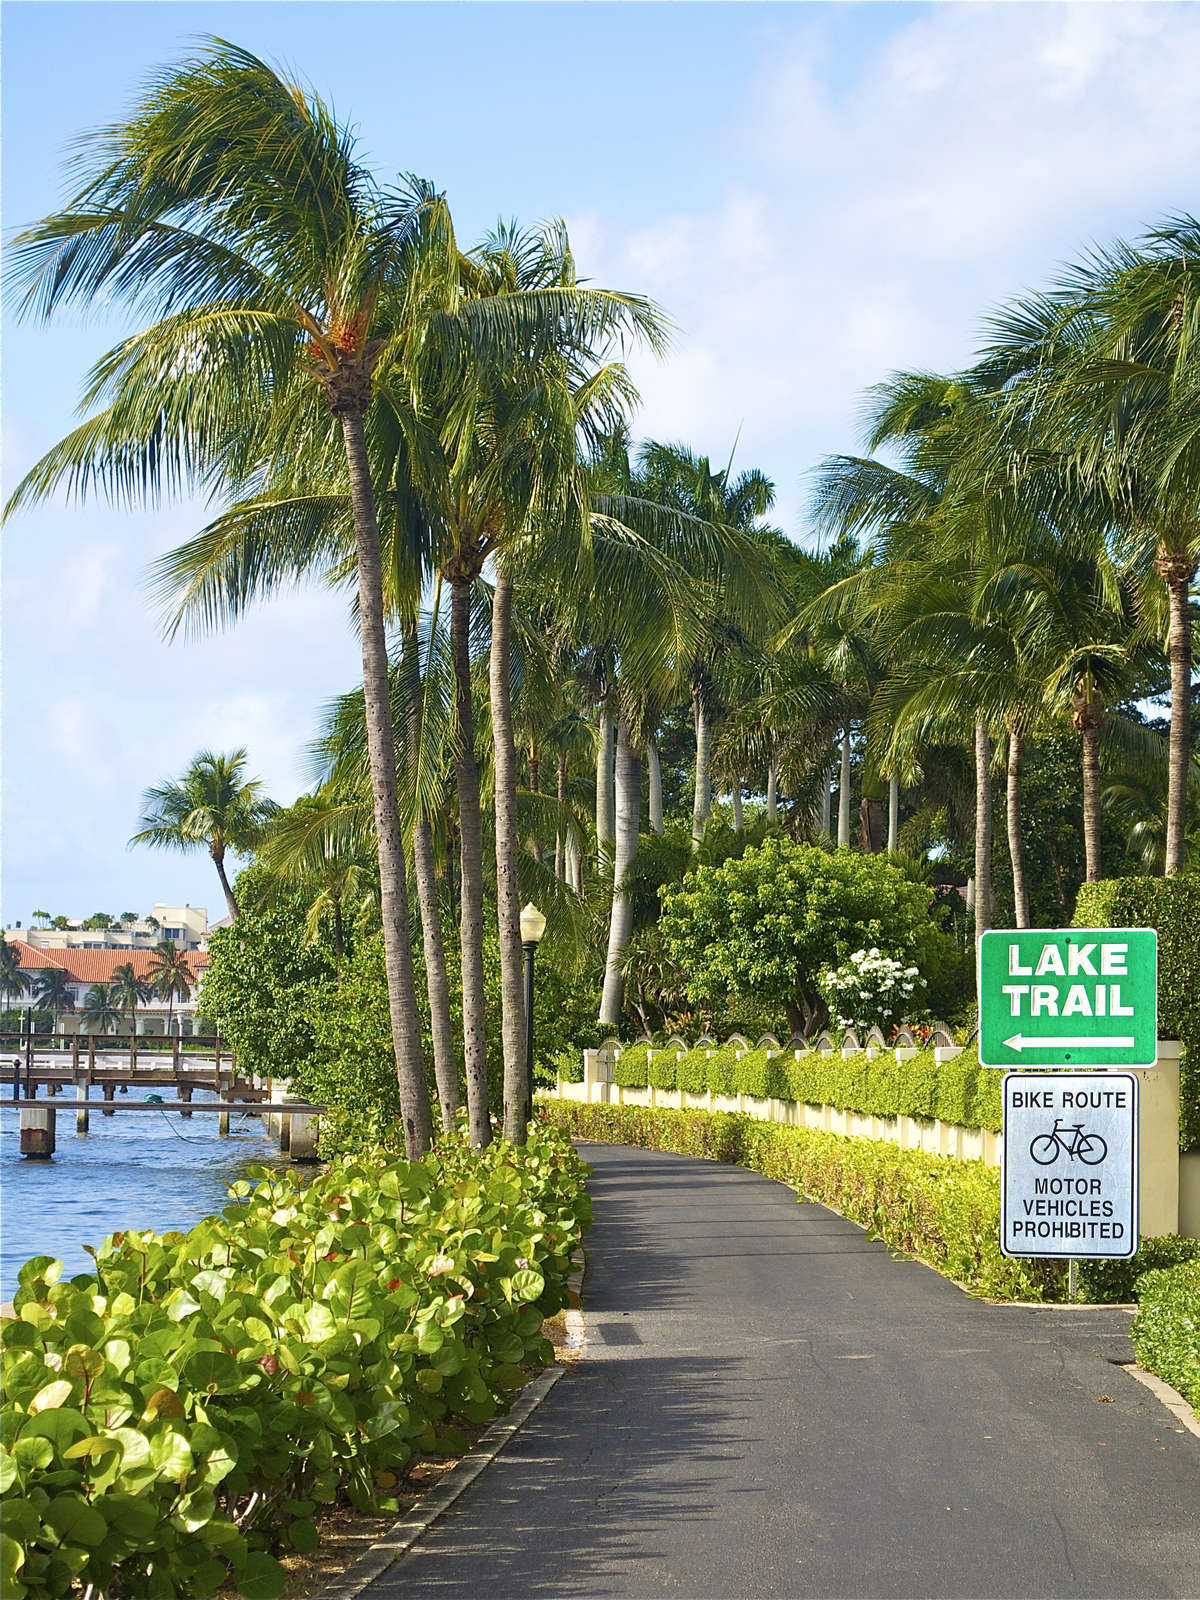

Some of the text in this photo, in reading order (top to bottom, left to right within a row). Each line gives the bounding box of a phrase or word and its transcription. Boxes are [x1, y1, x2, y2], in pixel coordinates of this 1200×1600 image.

[1008, 943, 1128, 976] LAKE
[1002, 984, 1134, 1016] TRAIL
[1012, 1091, 1126, 1108] BIKE ROUTE
[1034, 1178, 1101, 1195] MOTOR
[1023, 1200, 1113, 1217] VEHICLES
[1012, 1222, 1124, 1239] PROHIBITED
